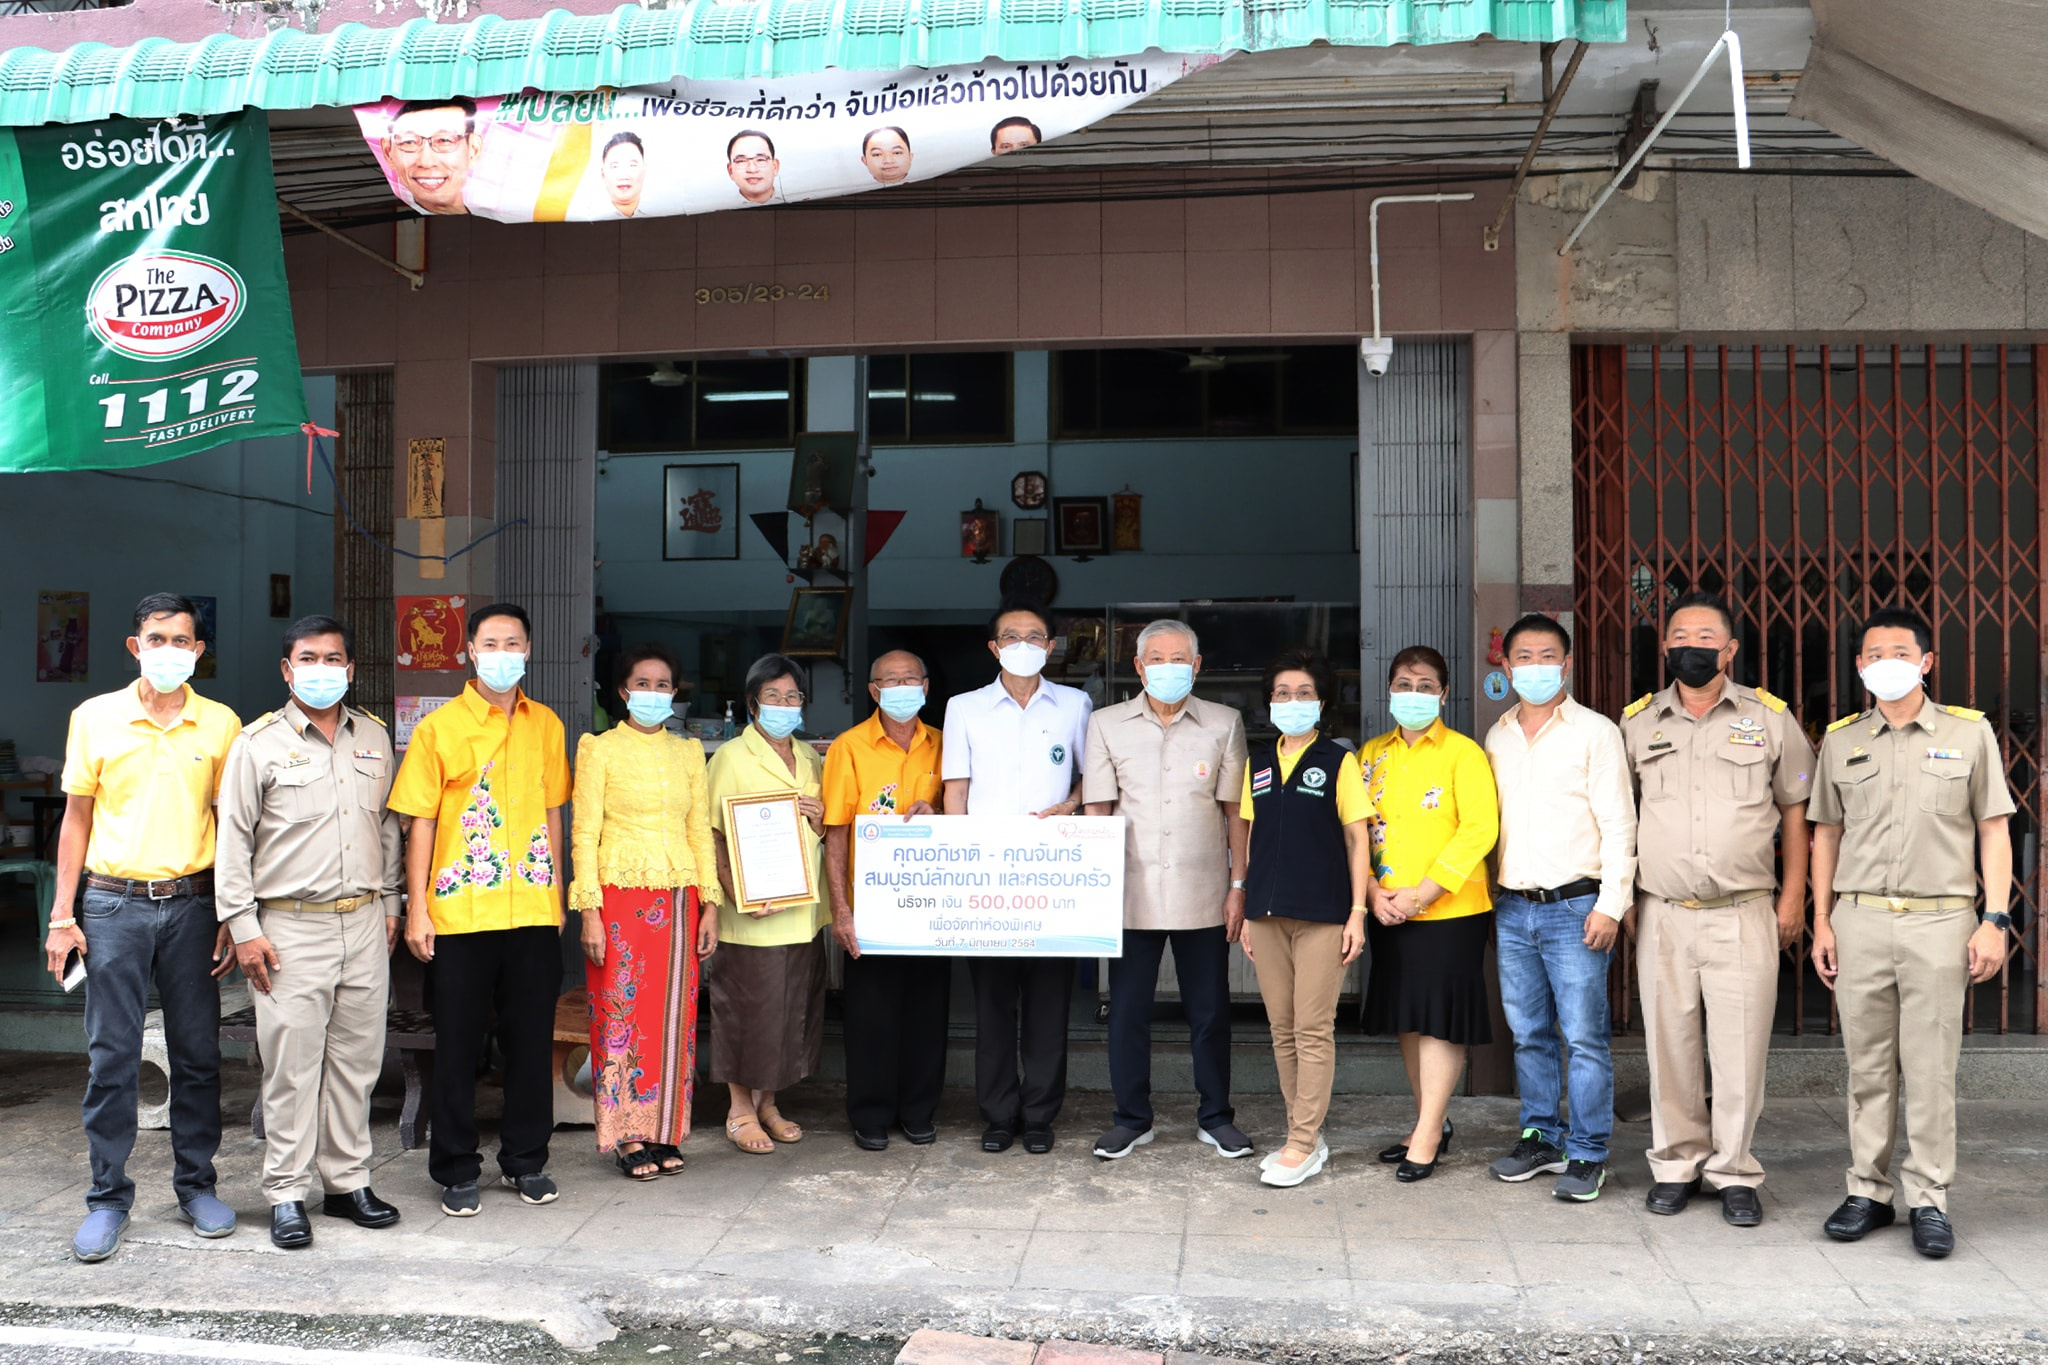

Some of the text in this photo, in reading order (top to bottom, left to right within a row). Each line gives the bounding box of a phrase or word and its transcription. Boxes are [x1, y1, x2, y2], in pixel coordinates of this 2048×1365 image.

[846, 61, 1148, 118] จับมือแล้วก้าวไปด้วยกัน
[146, 268, 176, 285] The
[115, 283, 220, 318] PIZZA
[694, 282, 831, 304] 305/23-24
[131, 316, 203, 337] Company
[89, 373, 109, 385] Call
[98, 369, 260, 428] 1112
[149, 409, 257, 443] FAST DELIVERY
[893, 843, 981, 867] คุณอภิชาติ
[1003, 842, 1083, 867] คุณจันทร์
[865, 866, 1112, 891] สมบูรณ์ลักขณา และครอบครัว
[897, 894, 1076, 911] บริจาค เงิน 500,000 บาท
[929, 913, 1042, 932] เพื่อจัดทำห้องพิเศษ
[959, 938, 965, 948] 7
[1011, 938, 1036, 948] 2564
